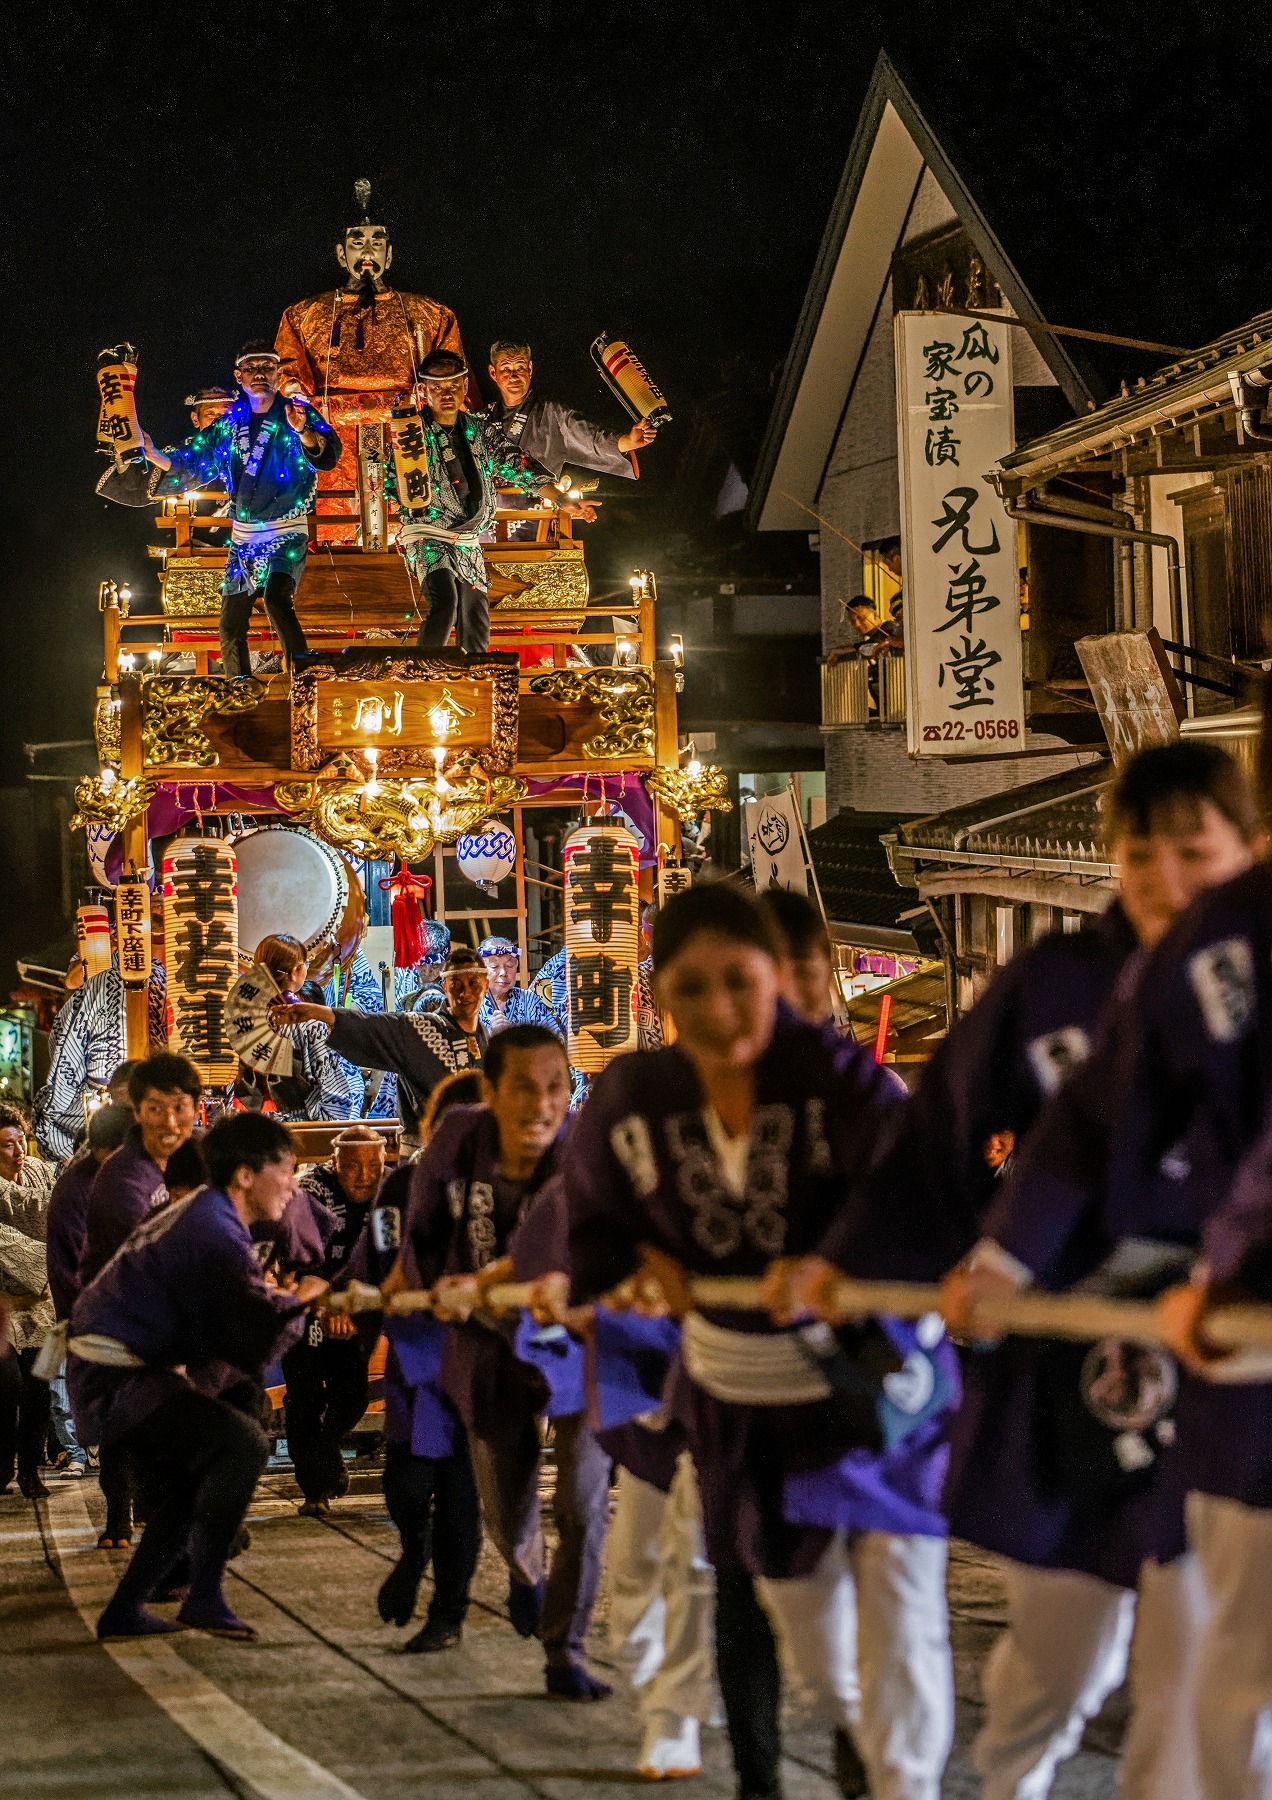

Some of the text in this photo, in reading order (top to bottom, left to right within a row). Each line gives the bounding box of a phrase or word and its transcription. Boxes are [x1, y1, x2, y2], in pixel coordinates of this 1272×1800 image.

[922, 340, 962, 467] 家宝漬
[955, 321, 999, 397] 瓜の
[398, 422, 432, 503] 幸町
[932, 486, 1002, 710] 兄弟堂
[943, 720, 1019, 741] 22-0568
[120, 888, 147, 972] 幸町下座連
[171, 844, 236, 1064] 幸若連
[569, 837, 634, 1049] 幸町
